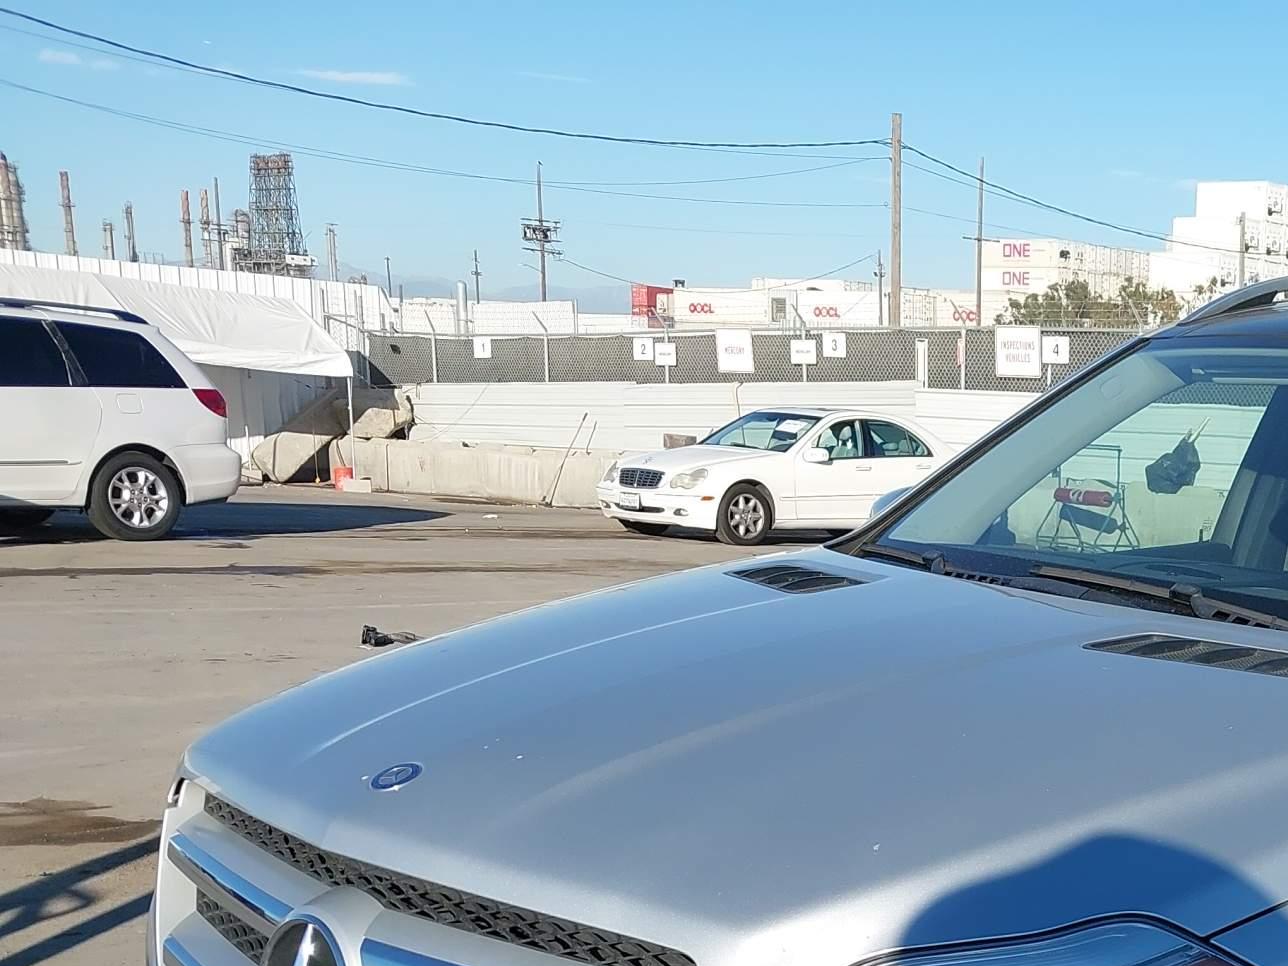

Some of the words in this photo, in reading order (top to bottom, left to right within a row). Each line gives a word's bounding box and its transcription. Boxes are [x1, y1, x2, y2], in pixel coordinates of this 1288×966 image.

[1002, 243, 1030, 257] ONE
[1002, 271, 1030, 286] ONE
[689, 303, 714, 314] OOCL
[813, 306, 841, 318] OOCL
[640, 343, 646, 354] 2
[831, 339, 838, 351] 3
[1052, 344, 1059, 356] 4
